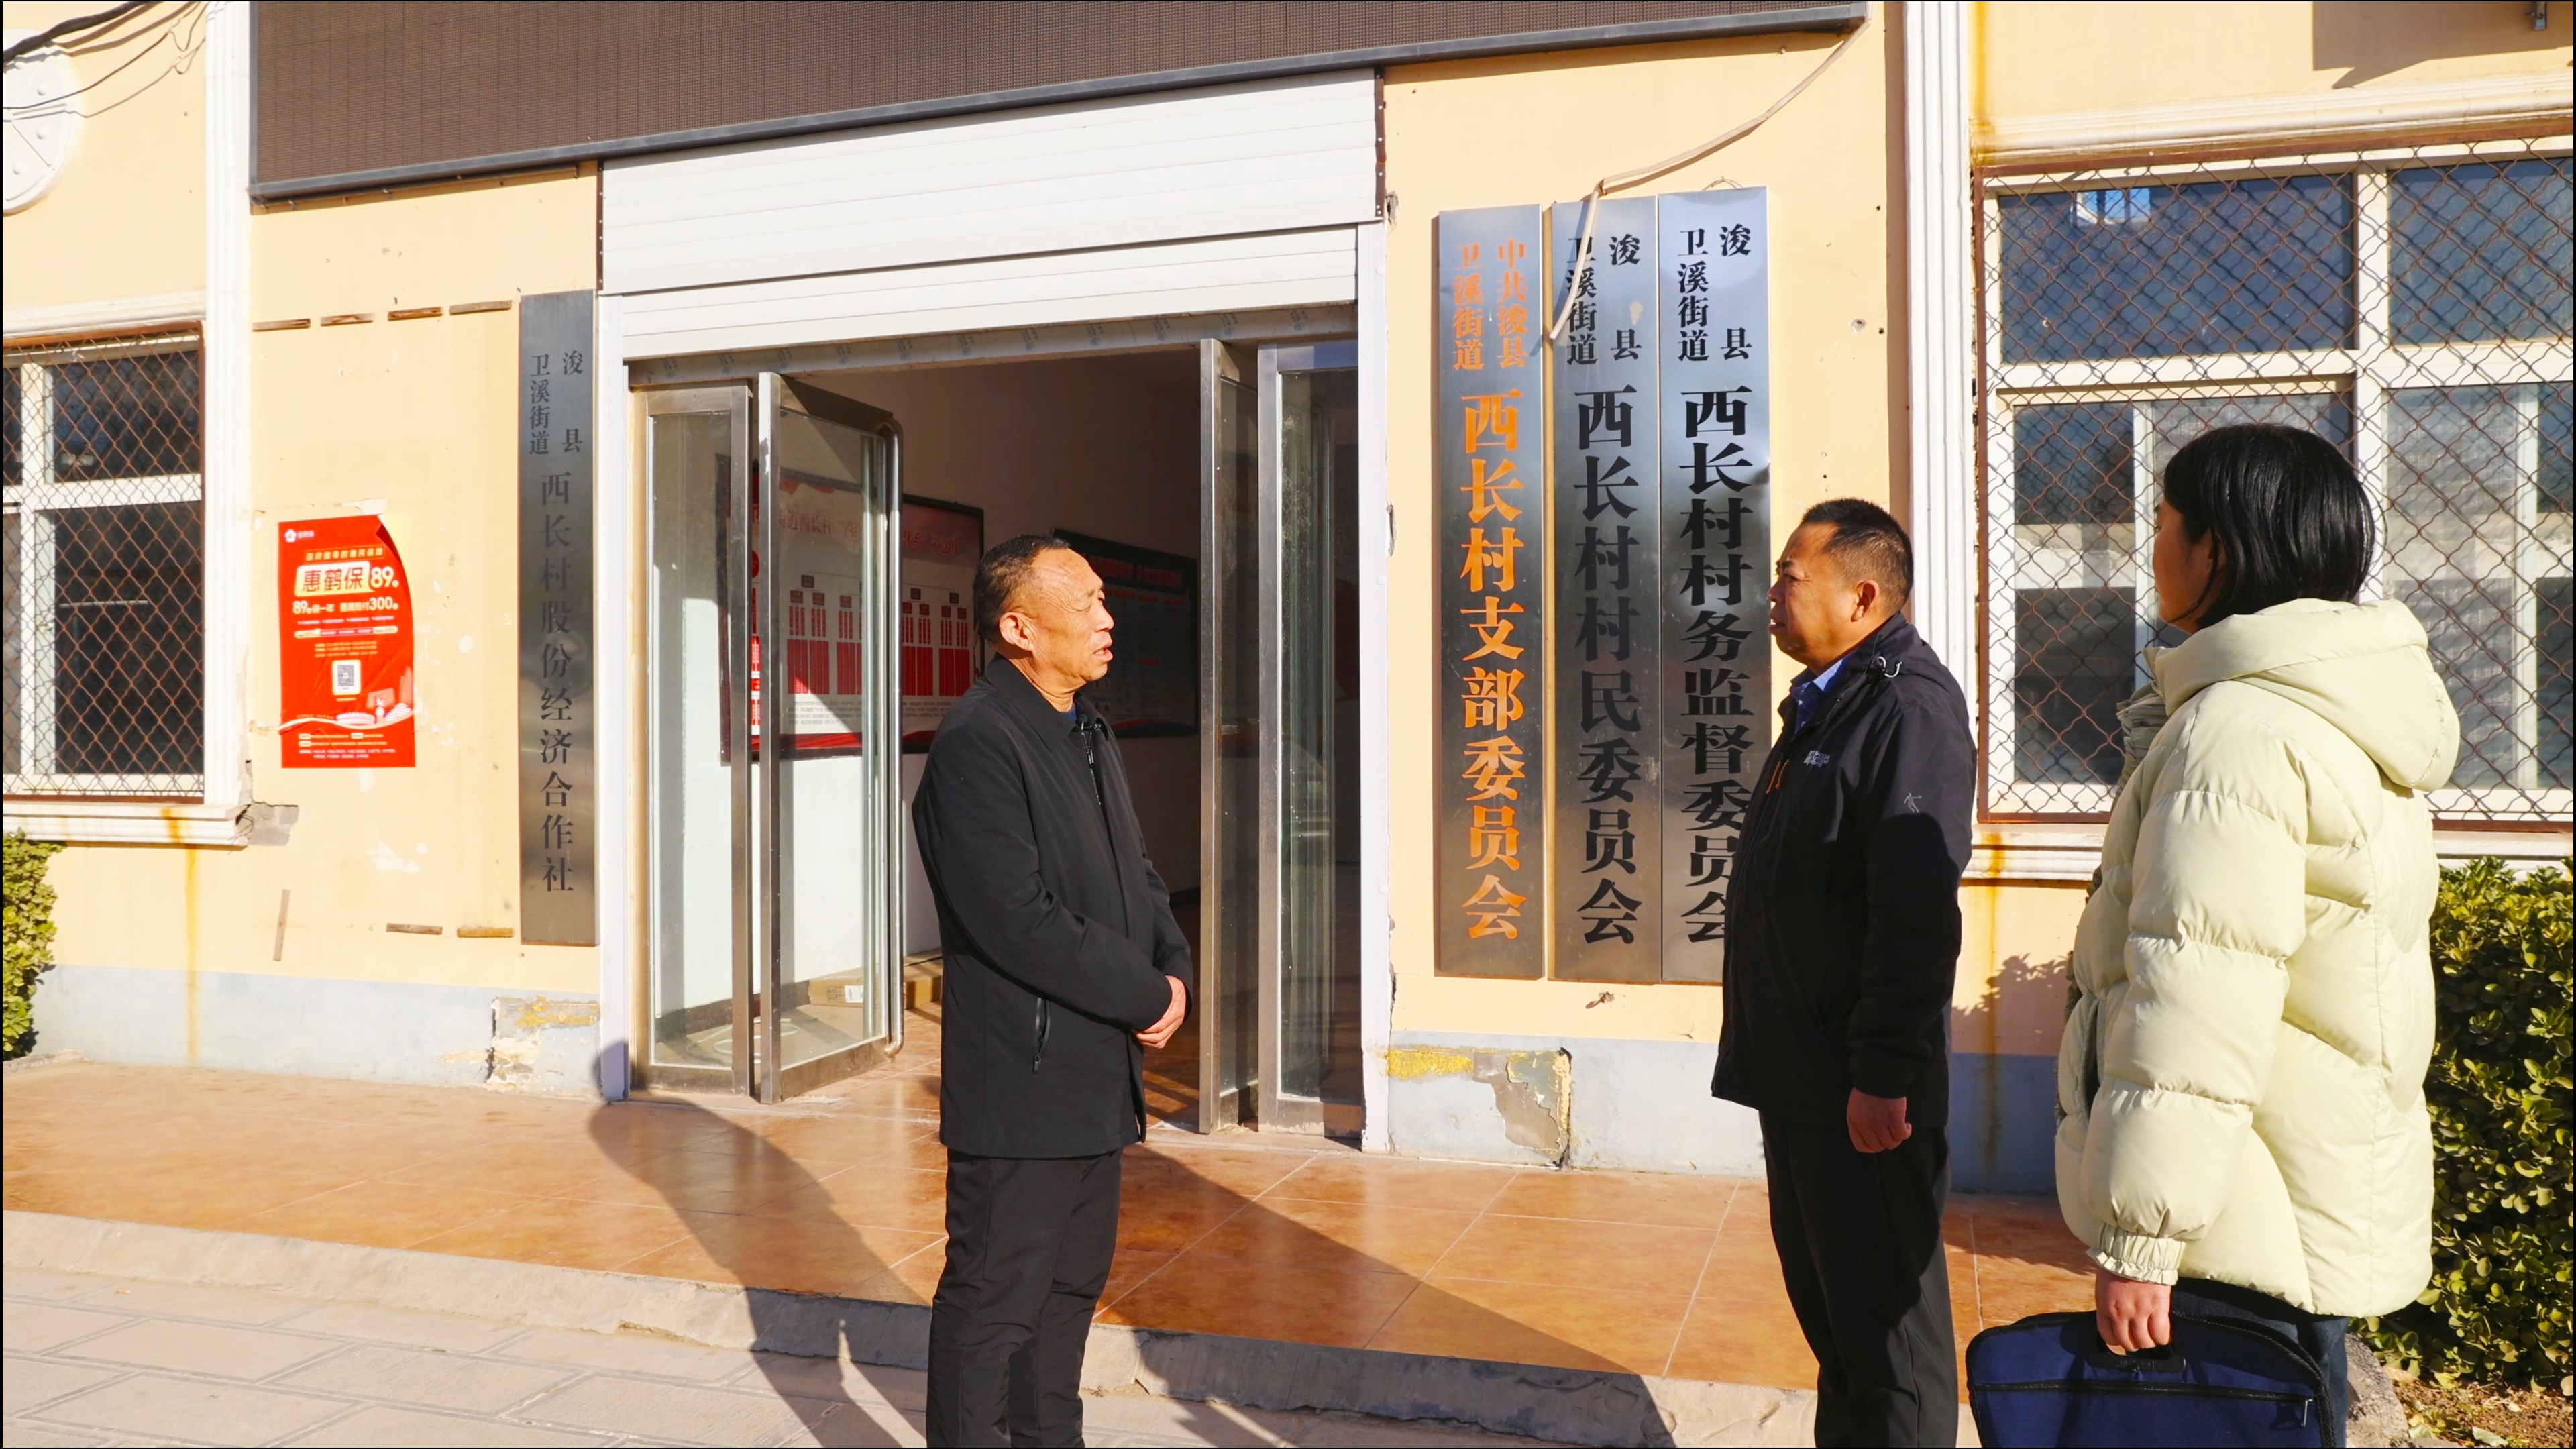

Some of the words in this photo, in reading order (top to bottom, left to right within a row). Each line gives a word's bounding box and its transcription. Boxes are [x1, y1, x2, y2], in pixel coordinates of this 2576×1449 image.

[1453, 244, 1484, 370] 卫溪街道
[1497, 238, 1528, 368] 中共浚县
[1677, 228, 1709, 362] 卫溪街道
[530, 354, 550, 455] 卫溪街道
[303, 567, 364, 592] 惠鹤保
[539, 471, 574, 892] 西长村股份经济合作社
[1460, 389, 1527, 939] 西长村支部委员会
[1573, 384, 1642, 944] 西长村村民委员会
